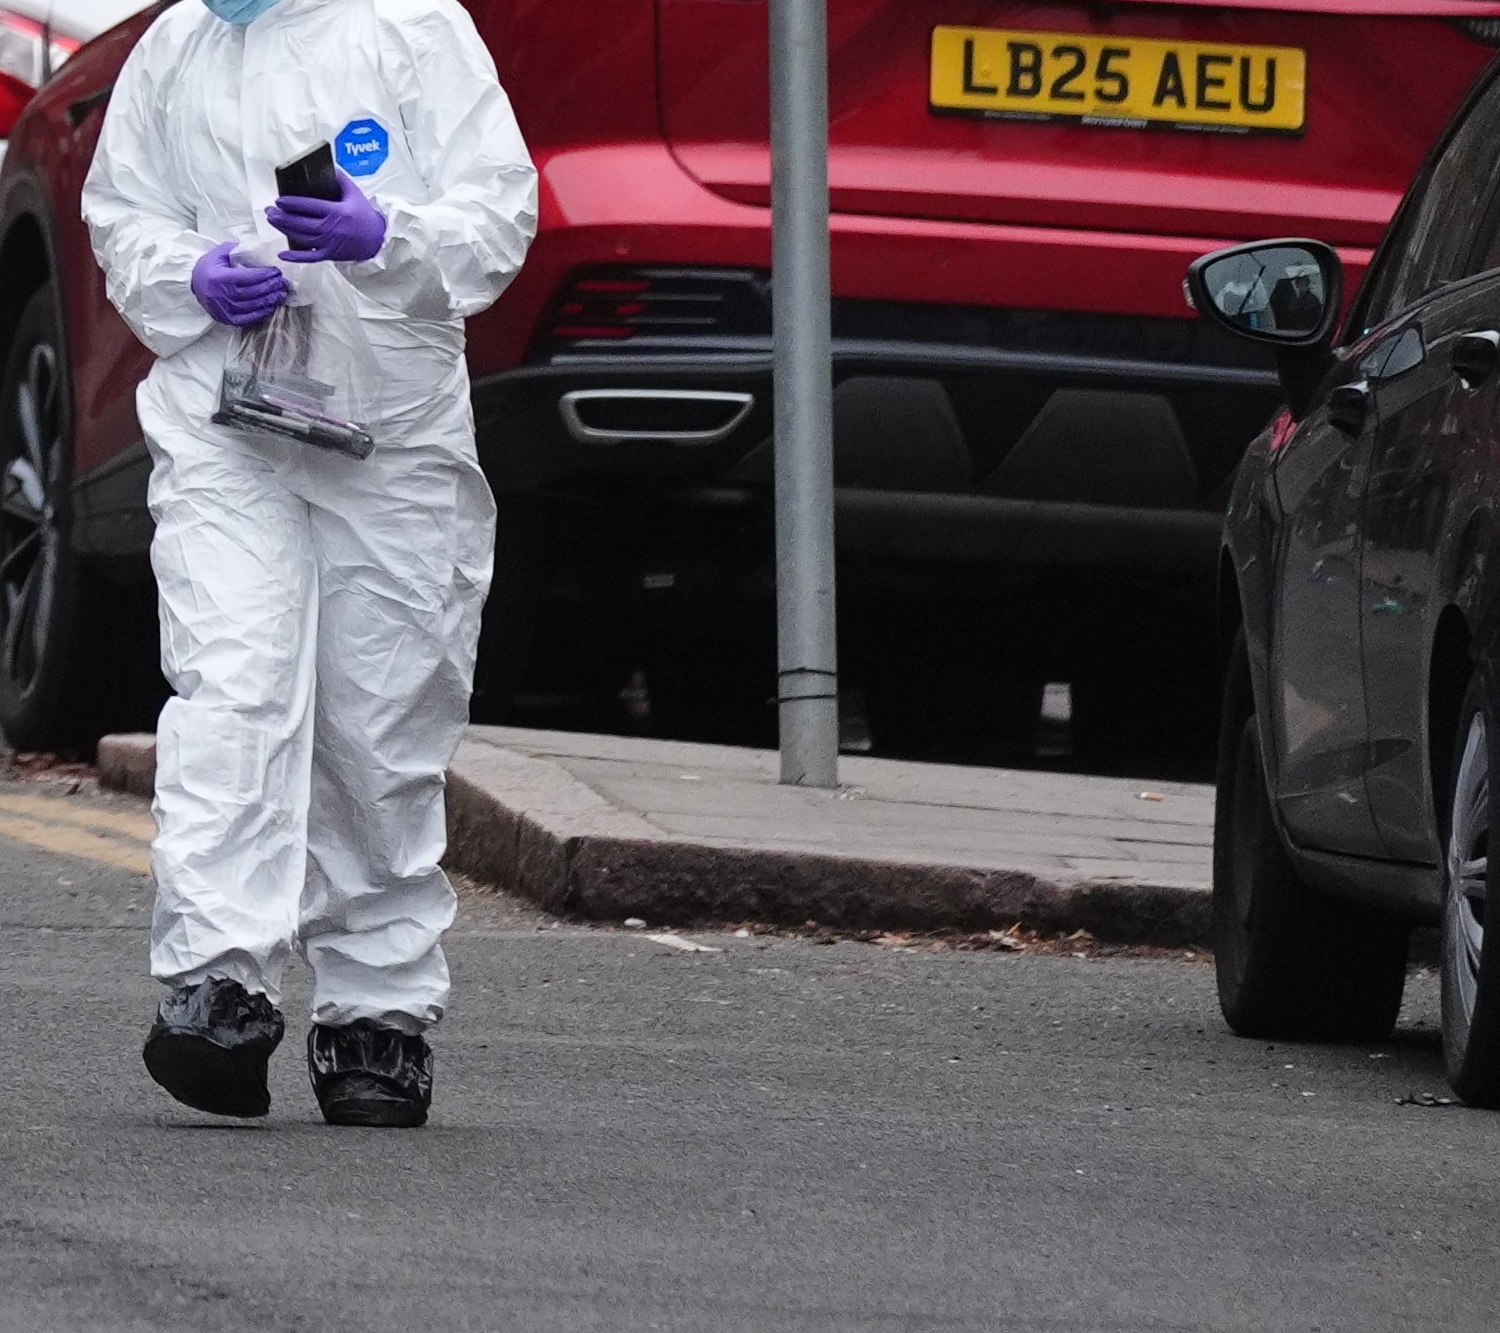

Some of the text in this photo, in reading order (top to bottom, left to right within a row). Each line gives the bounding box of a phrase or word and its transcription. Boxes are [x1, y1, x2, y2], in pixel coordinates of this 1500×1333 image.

[962, 37, 1277, 114] LB25 AEU
[344, 138, 381, 157] Tyvek
